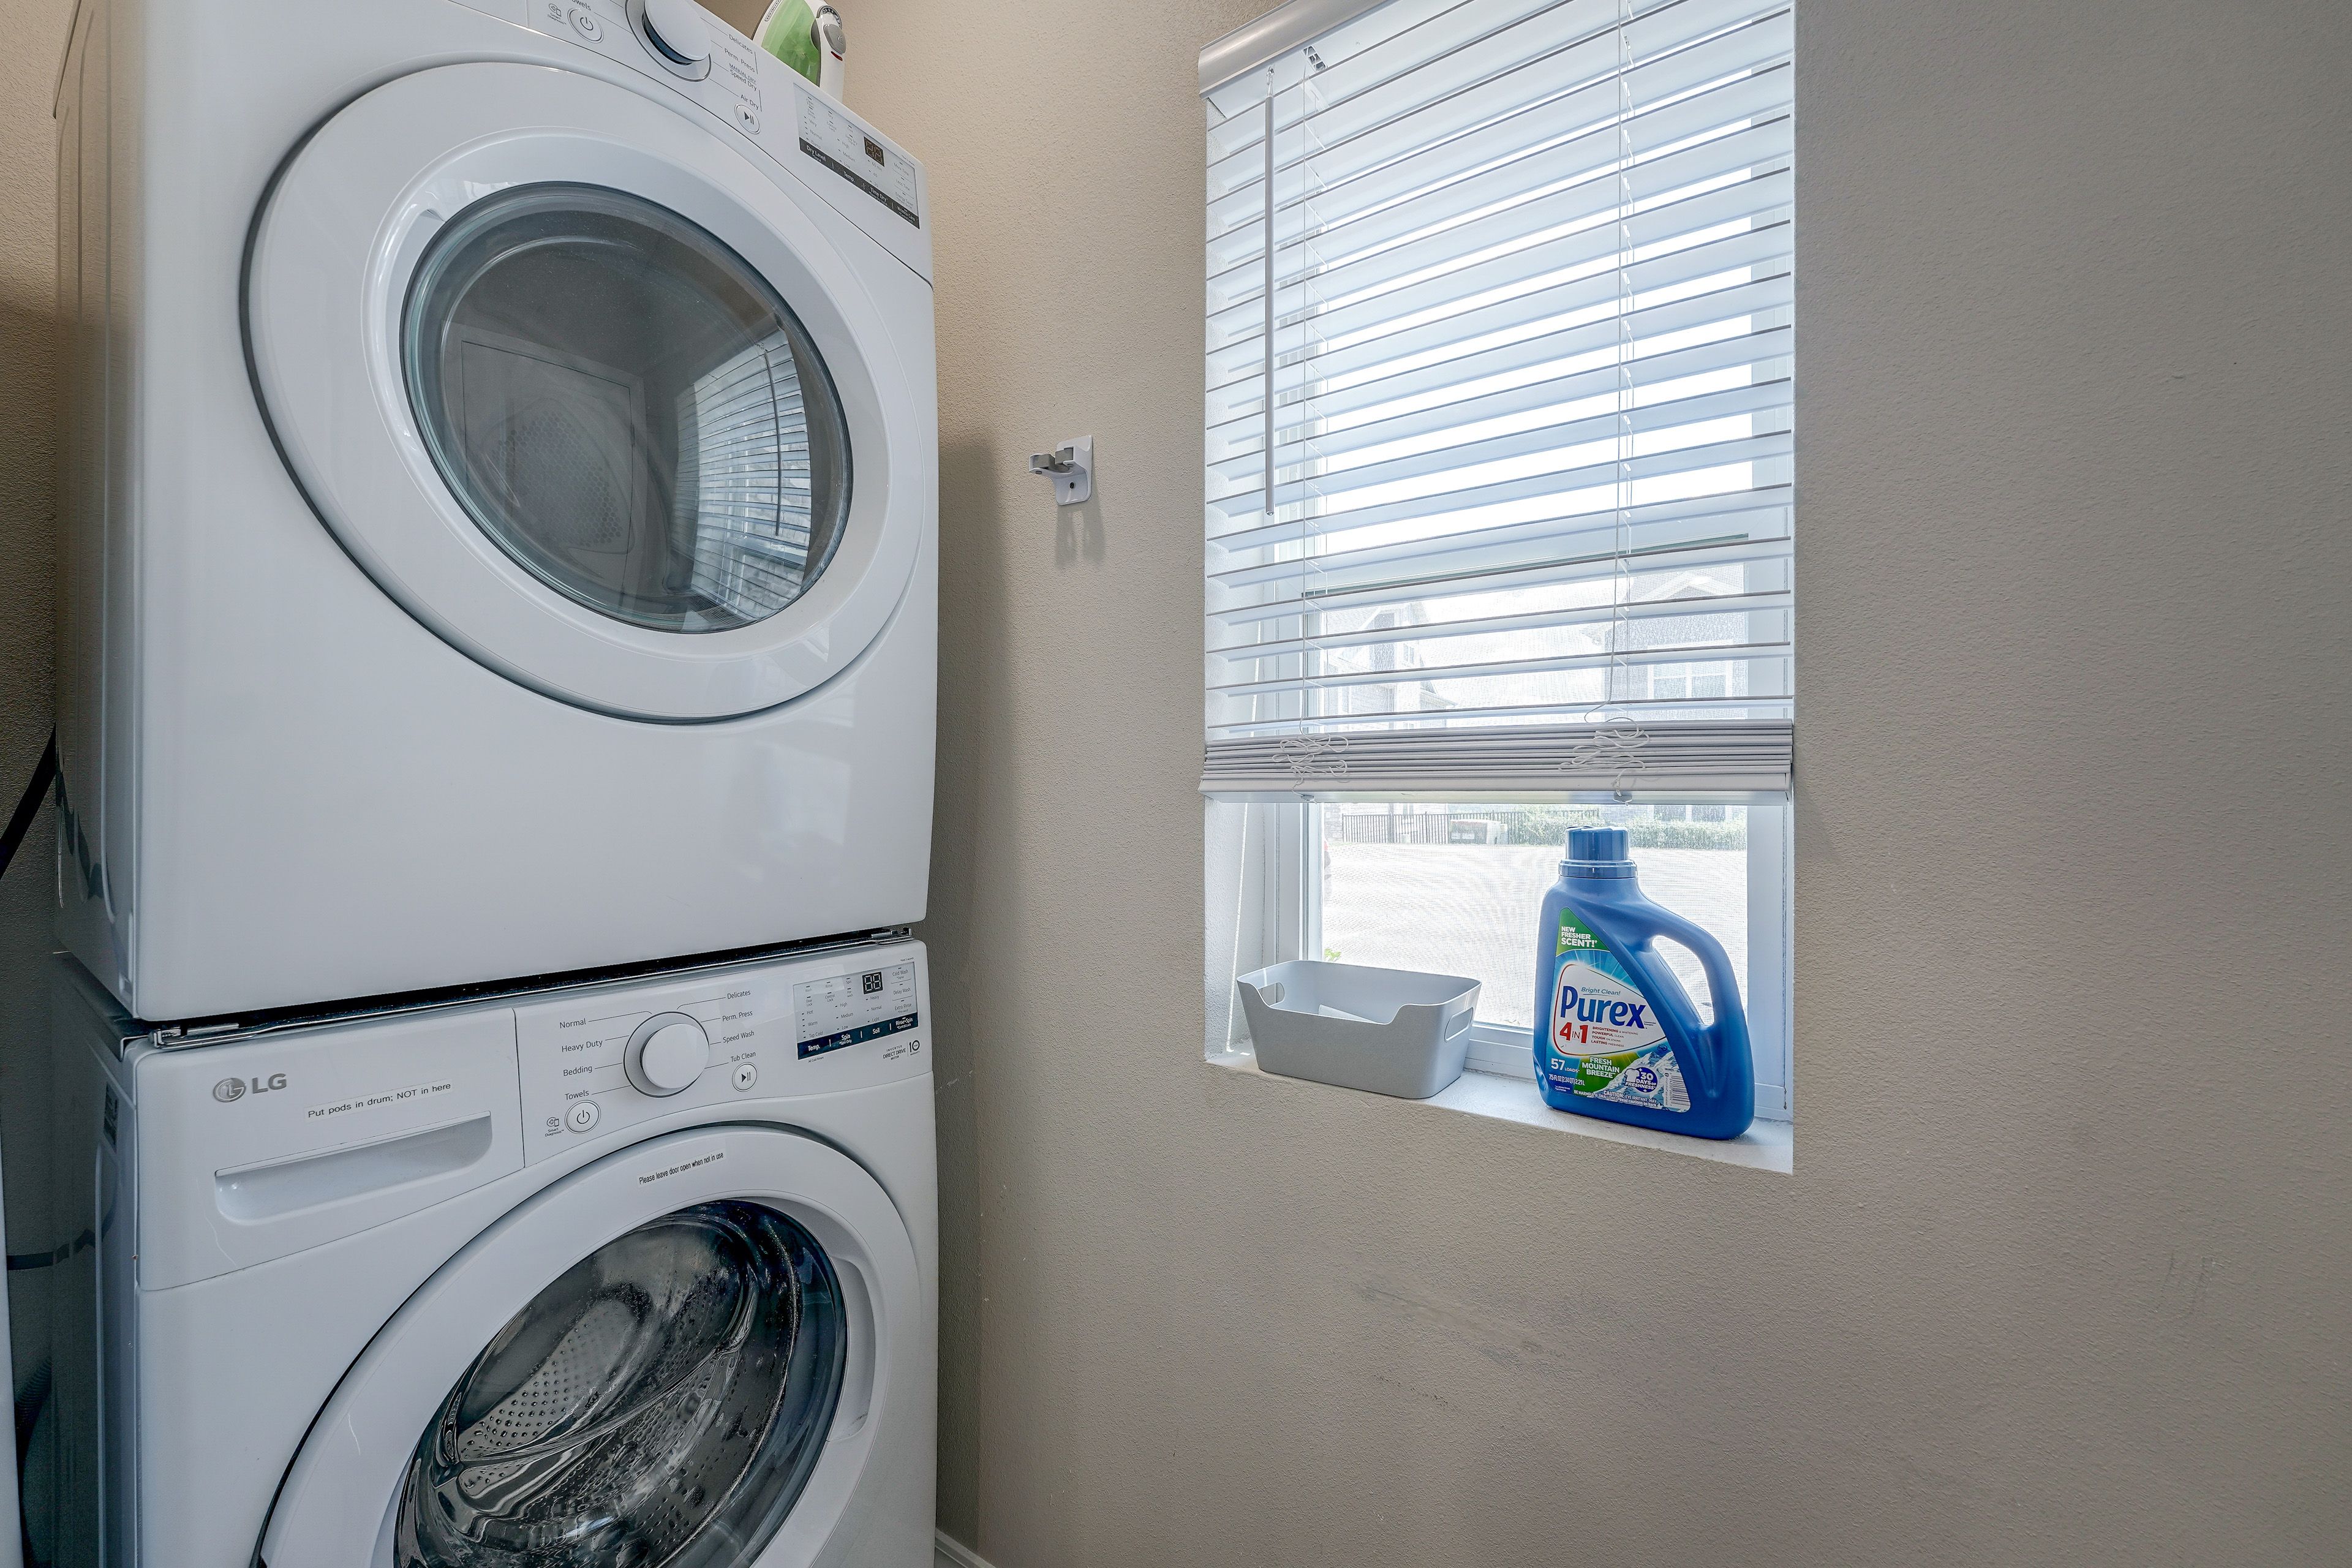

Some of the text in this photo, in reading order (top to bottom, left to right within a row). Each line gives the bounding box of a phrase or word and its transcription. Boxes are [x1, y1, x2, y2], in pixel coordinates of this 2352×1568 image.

[729, 34, 753, 55] Delicates
[724, 48, 755, 73] Perm. Press
[729, 69, 756, 92] Speed Dry
[749, 99, 759, 110] Dry
[806, 145, 815, 154] Dry
[815, 150, 826, 162] Level
[870, 187, 880, 197] Time
[727, 990, 751, 1000] Delicates
[1560, 986, 1646, 1029] Purex
[560, 1018, 586, 1028] Normal
[723, 1030, 755, 1043] Speed Wash
[562, 1040, 603, 1052] Heavy Duty
[910, 1039, 920, 1053] 10
[1551, 1058, 1566, 1071] 57
[1581, 1062, 1620, 1073] MOUNTAIN
[1589, 1057, 1612, 1066] FRESH
[563, 1066, 592, 1076] Bedding
[1640, 1072, 1654, 1081] 30
[252, 1073, 287, 1095] LG
[308, 1109, 325, 1118] Put
[328, 1104, 352, 1115] pods
[367, 1095, 393, 1106] drum;
[397, 1089, 417, 1100] NOT
[432, 1082, 451, 1093] here
[565, 1090, 589, 1100] Towels
[639, 1174, 655, 1185] Please
[655, 1170, 669, 1180] leave
[669, 1166, 680, 1175] door
[680, 1163, 692, 1172] open
[691, 1159, 703, 1167] when
